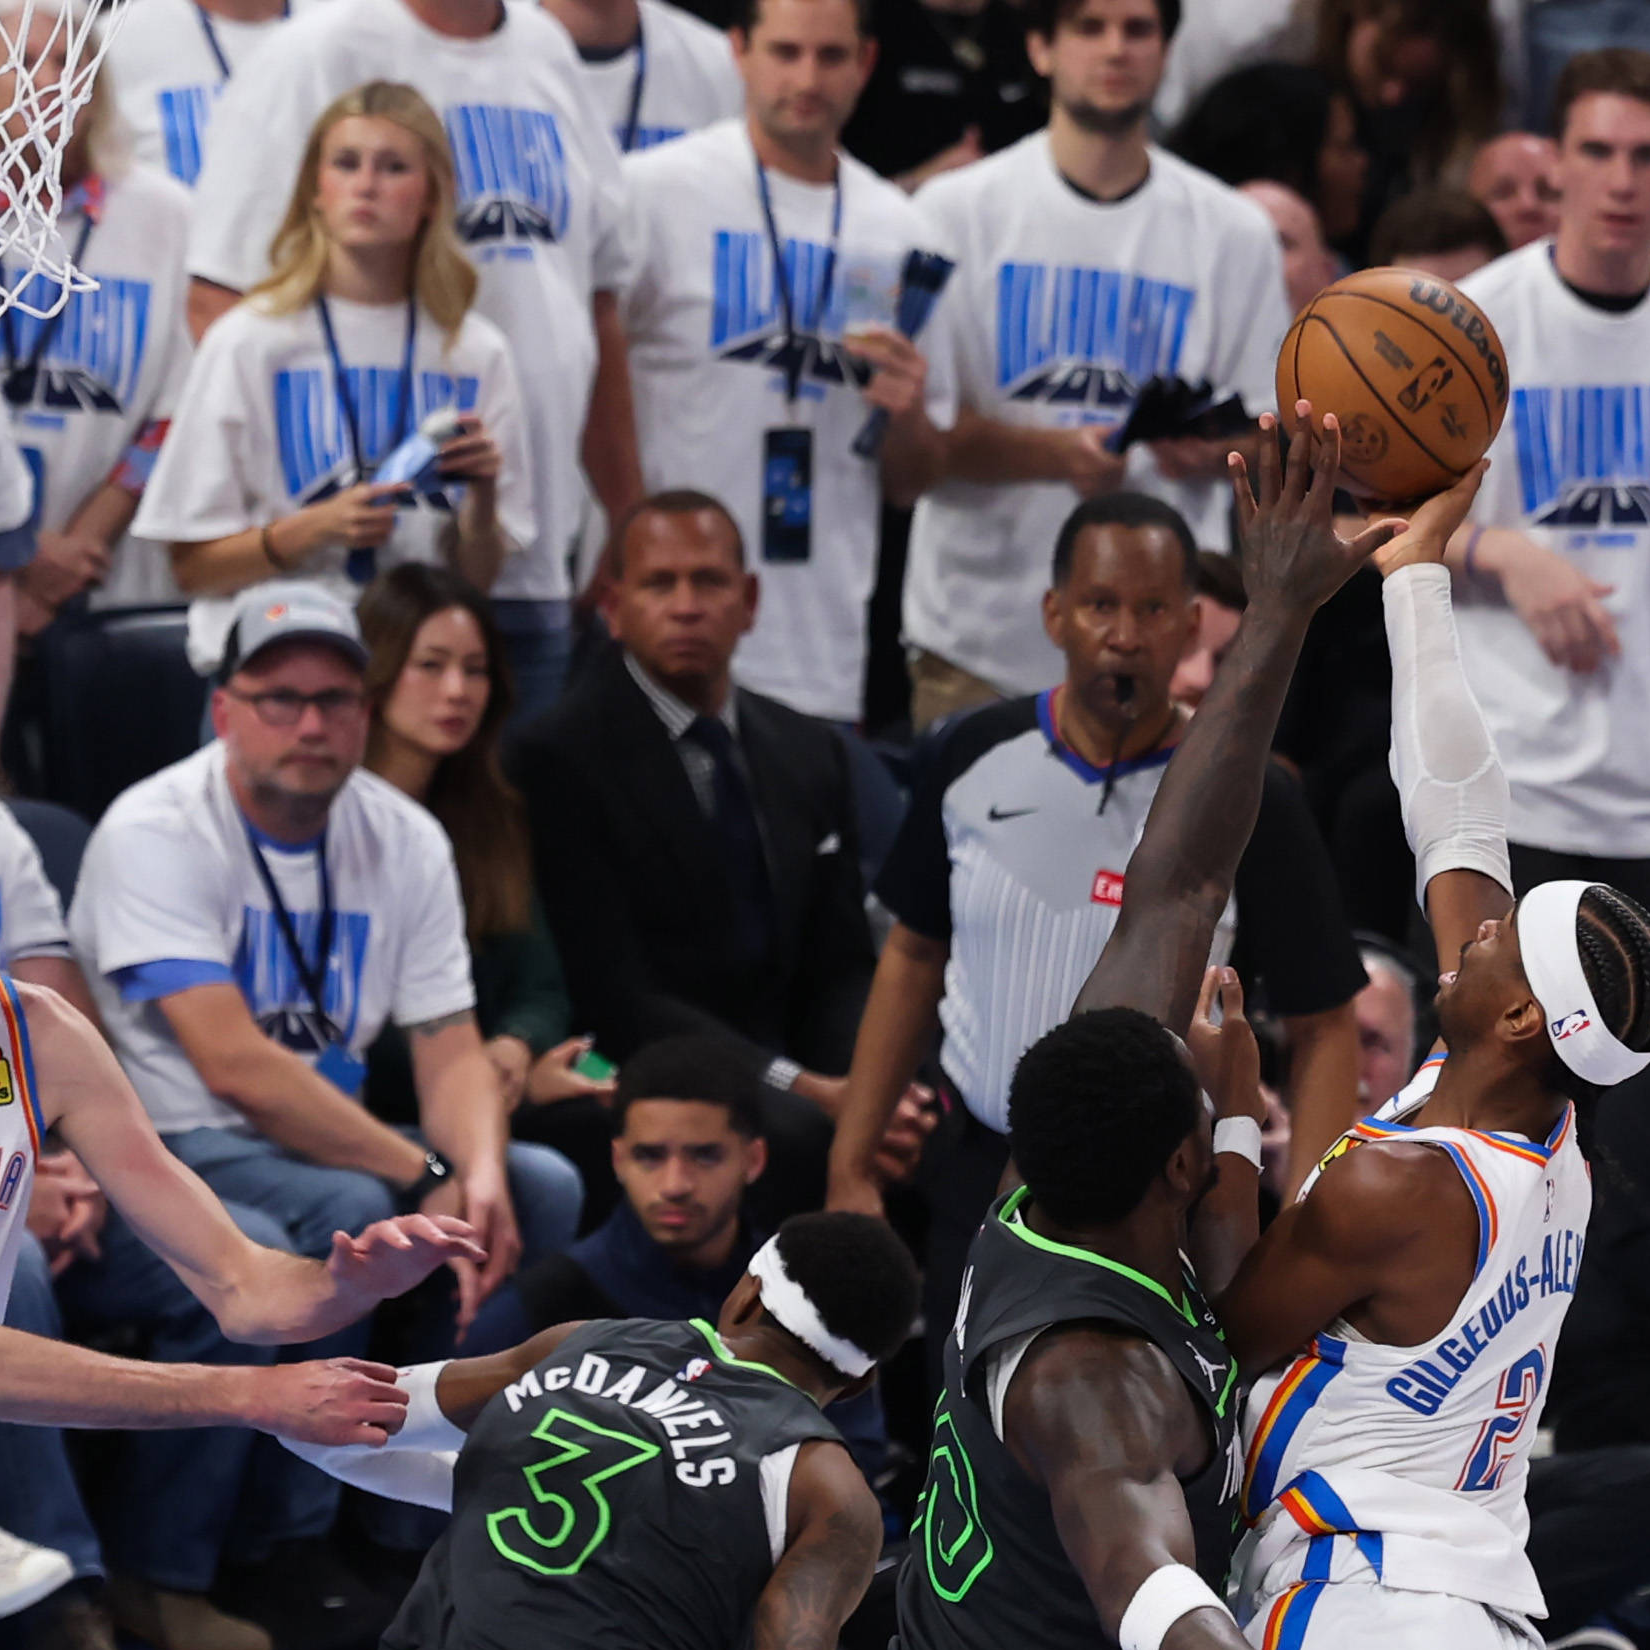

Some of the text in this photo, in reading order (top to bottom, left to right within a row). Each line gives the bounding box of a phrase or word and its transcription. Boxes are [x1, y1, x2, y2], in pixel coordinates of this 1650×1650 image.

[1410, 279, 1506, 405] Wilson
[1386, 1229, 1584, 1416] GILGEOUS-ALEX
[486, 1407, 662, 1575] 3
[504, 1353, 737, 1488] McDANIELS
[1453, 1343, 1546, 1492] 2
